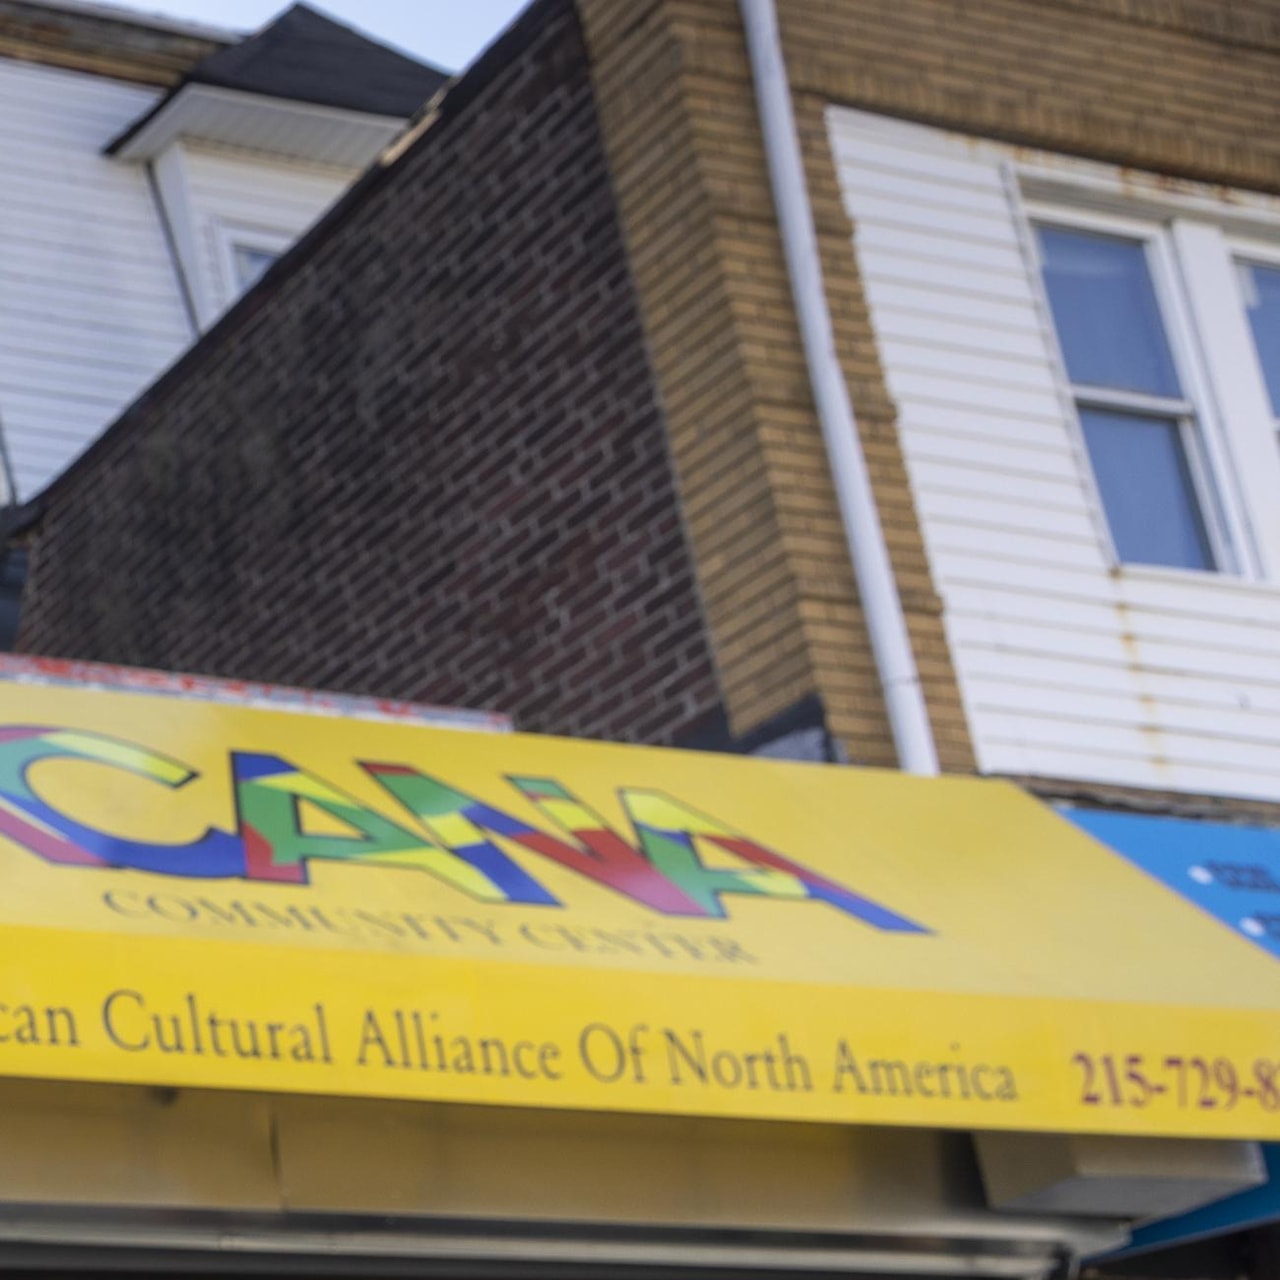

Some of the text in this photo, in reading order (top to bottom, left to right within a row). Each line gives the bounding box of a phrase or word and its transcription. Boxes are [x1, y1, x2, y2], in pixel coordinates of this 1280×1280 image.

[101, 888, 760, 965] COMMUNITY CENTER
[100, 988, 334, 1065] Cultural
[355, 1008, 562, 1081] Alliance
[578, 1021, 650, 1085] Of
[661, 1026, 816, 1094] North
[831, 1039, 1020, 1101] America
